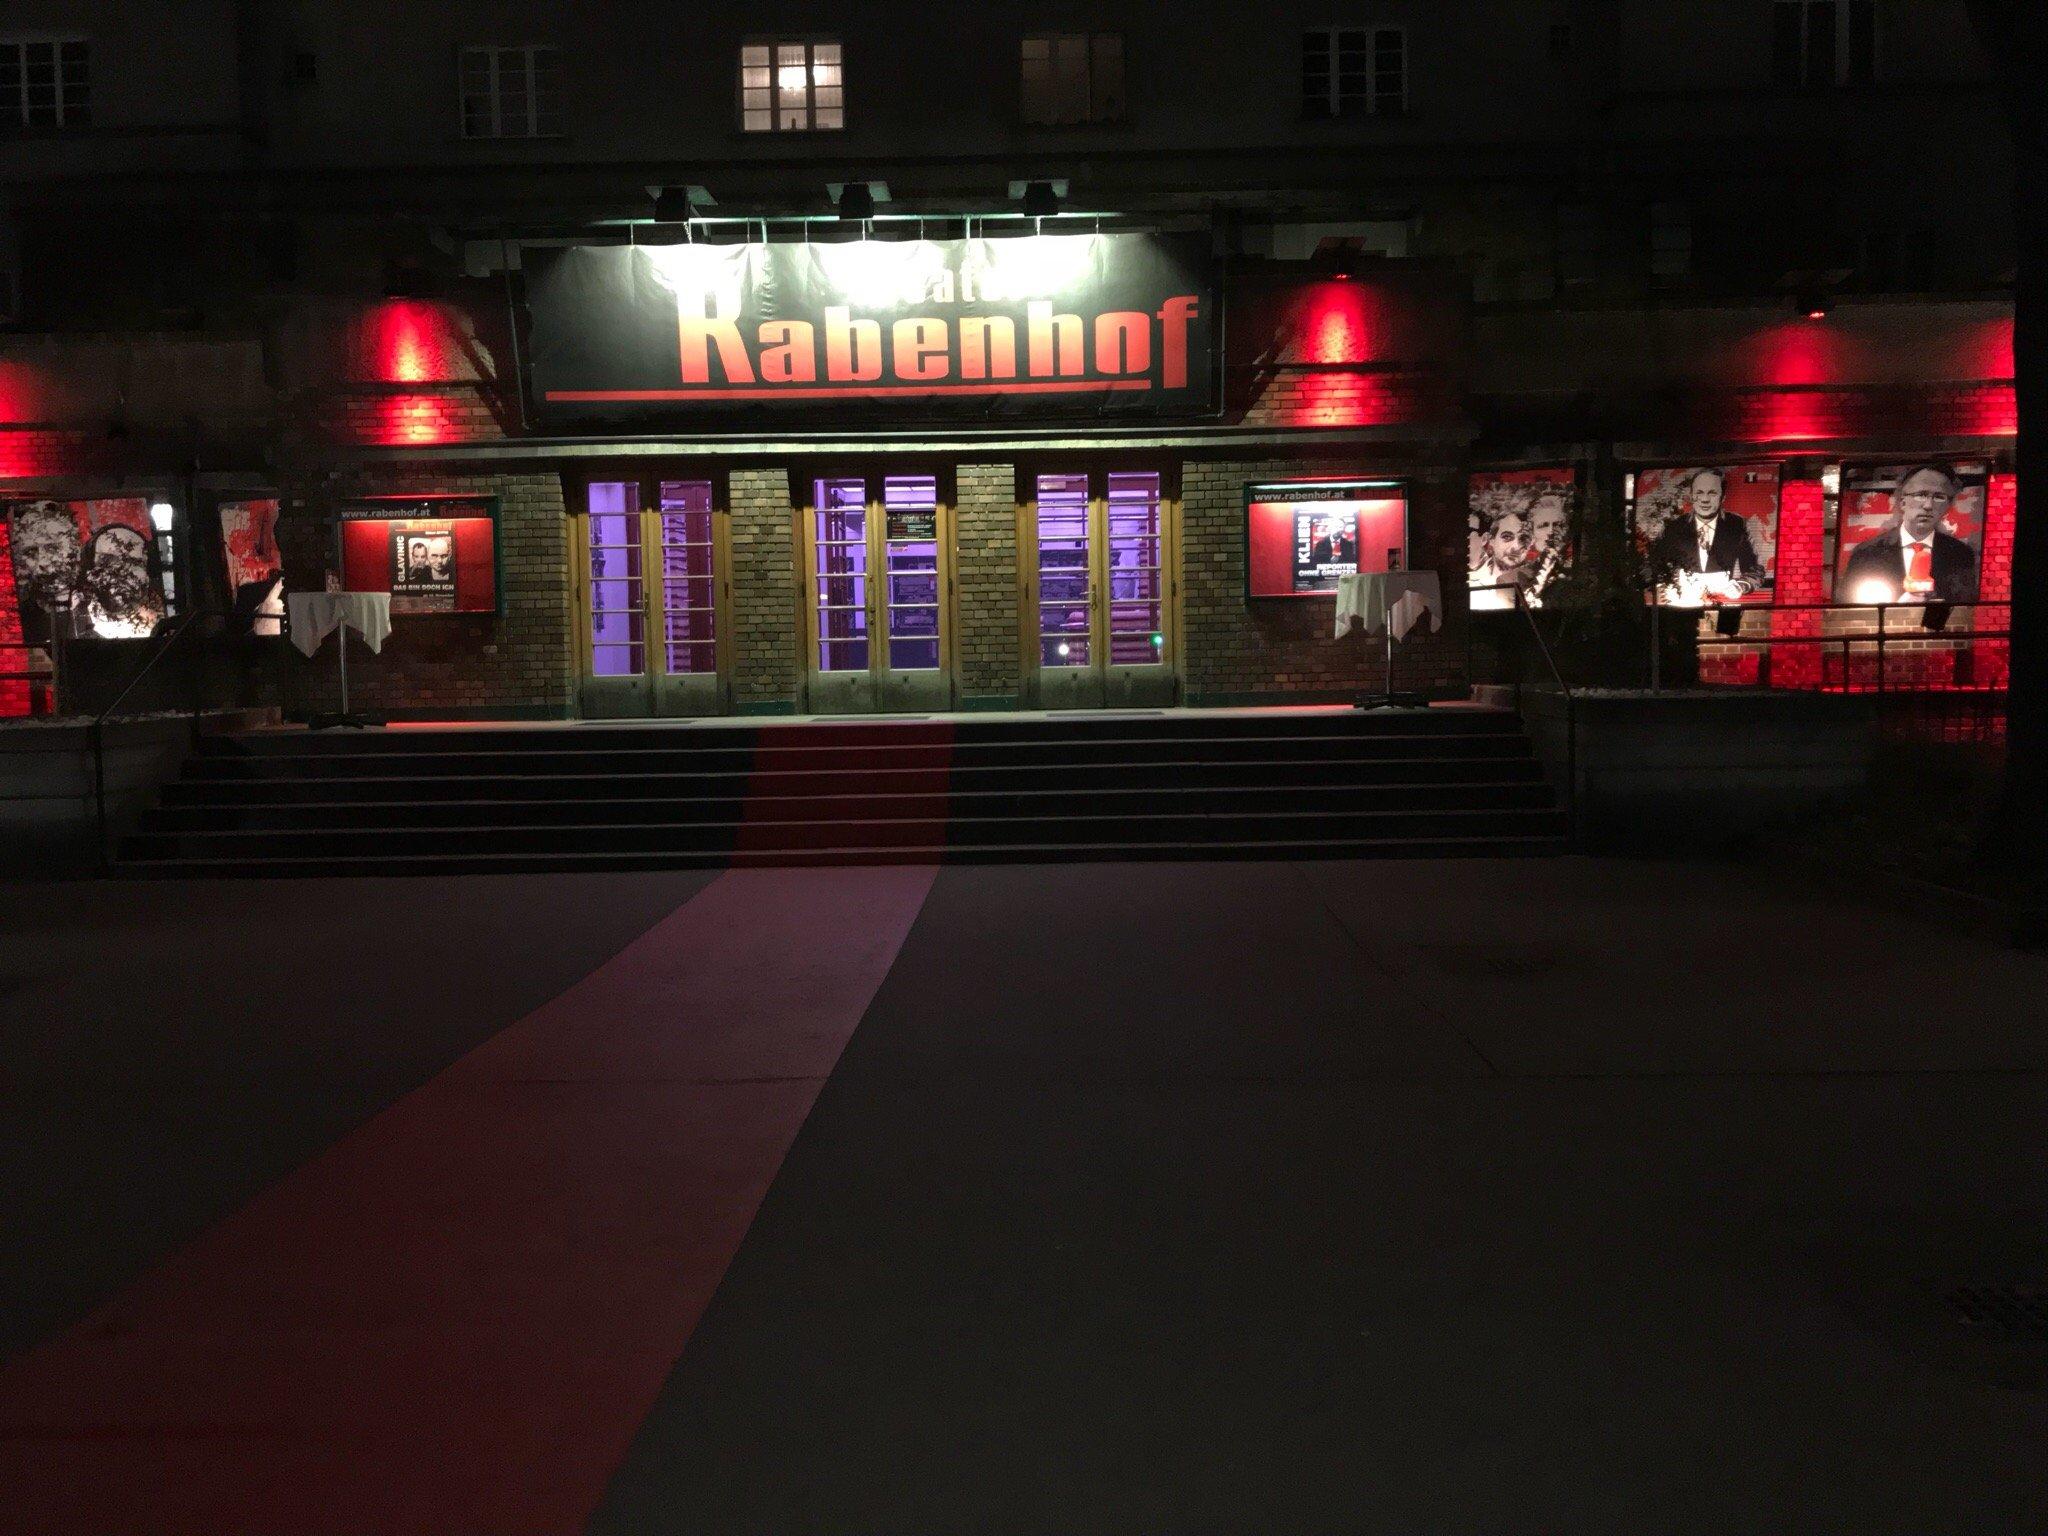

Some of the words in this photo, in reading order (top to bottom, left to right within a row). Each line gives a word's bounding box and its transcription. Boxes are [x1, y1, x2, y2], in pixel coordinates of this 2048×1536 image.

[677, 272, 1198, 389] Rabenhof
[341, 508, 430, 518] www.rabenhof.at
[1254, 490, 1345, 501] www.rabenhof.at
[396, 535, 405, 582] GLAVINIC
[1297, 516, 1311, 563] KLIEN
